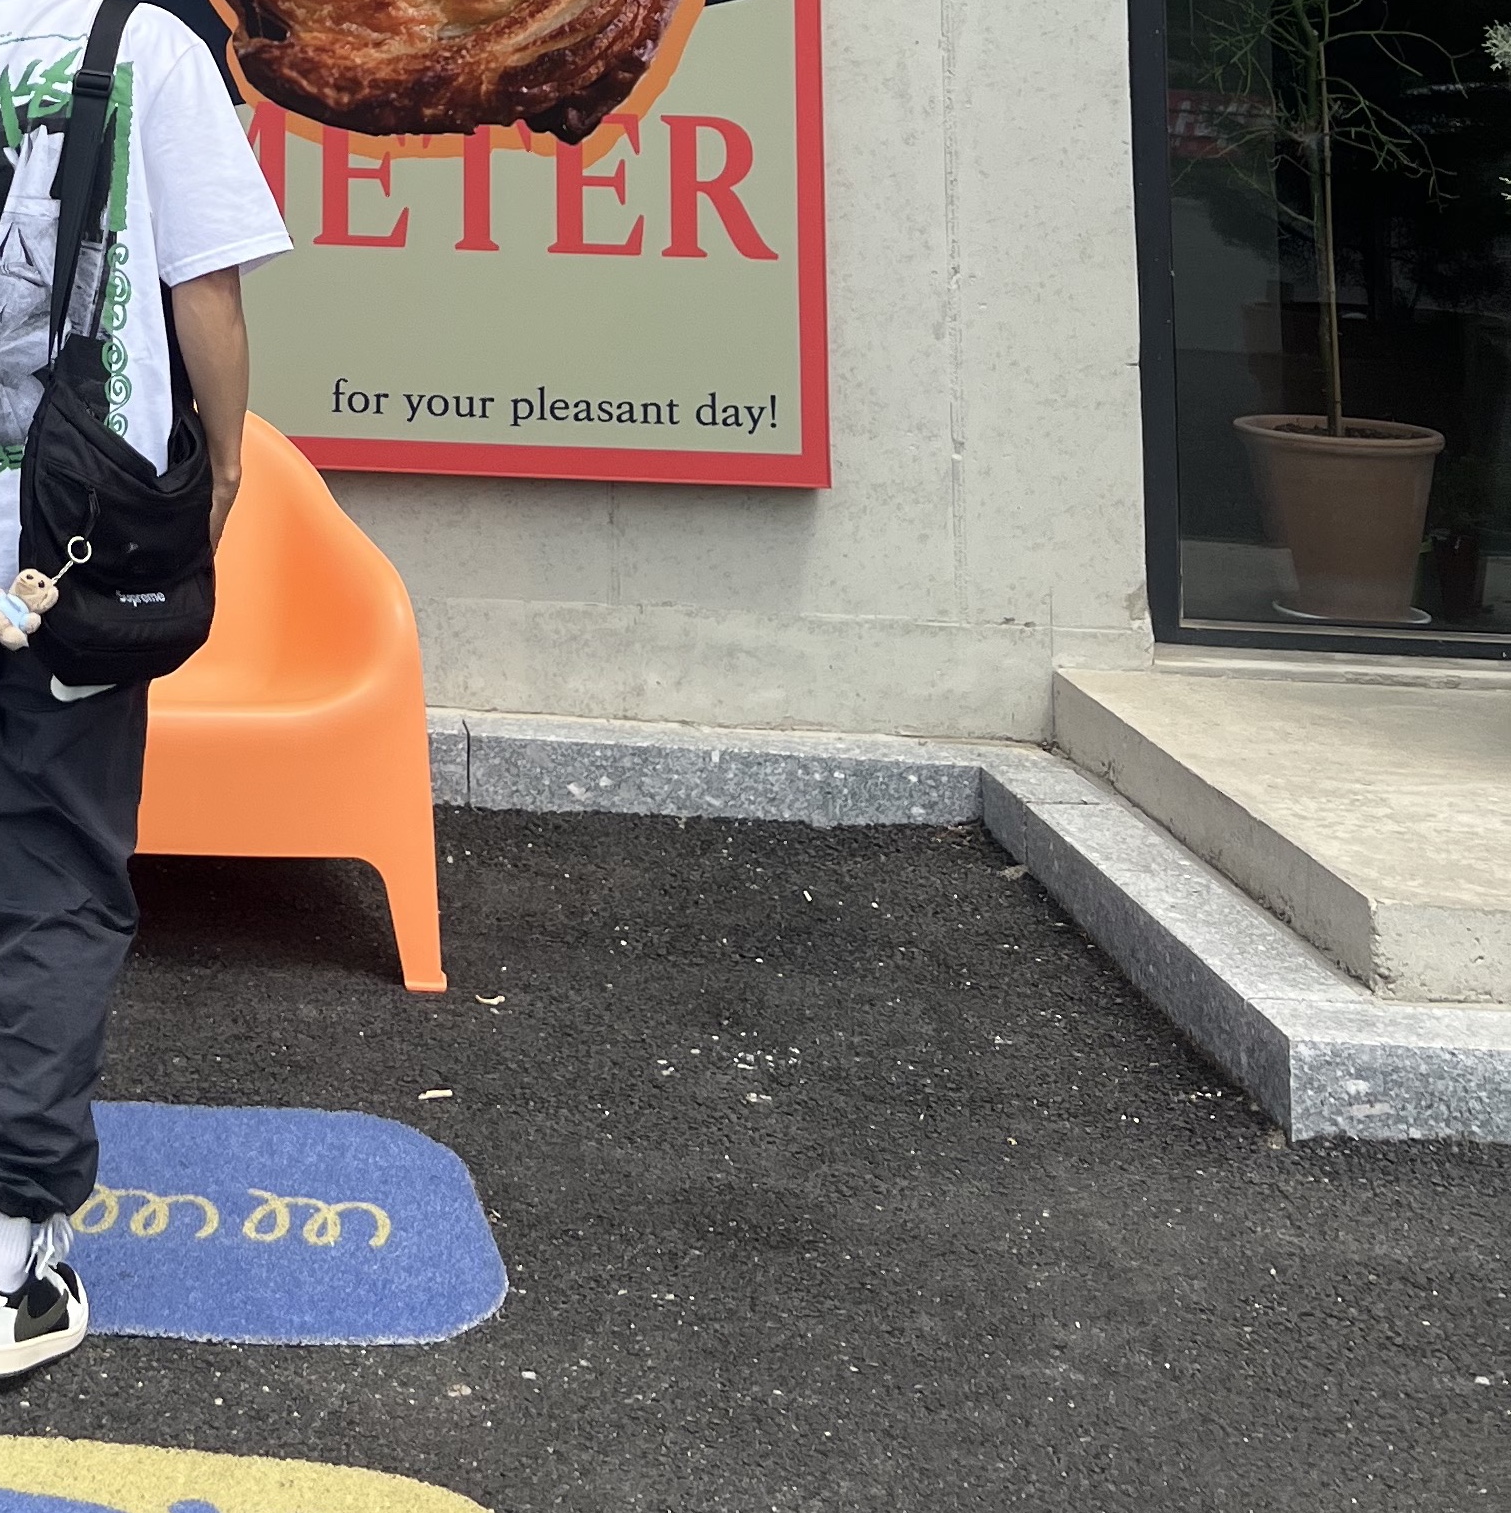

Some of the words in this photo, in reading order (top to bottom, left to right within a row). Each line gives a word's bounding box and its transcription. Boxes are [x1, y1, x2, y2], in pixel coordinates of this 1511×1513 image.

[331, 378, 389, 414] for
[402, 391, 495, 422] your
[509, 385, 681, 428] pleasant
[695, 392, 779, 434] day!
